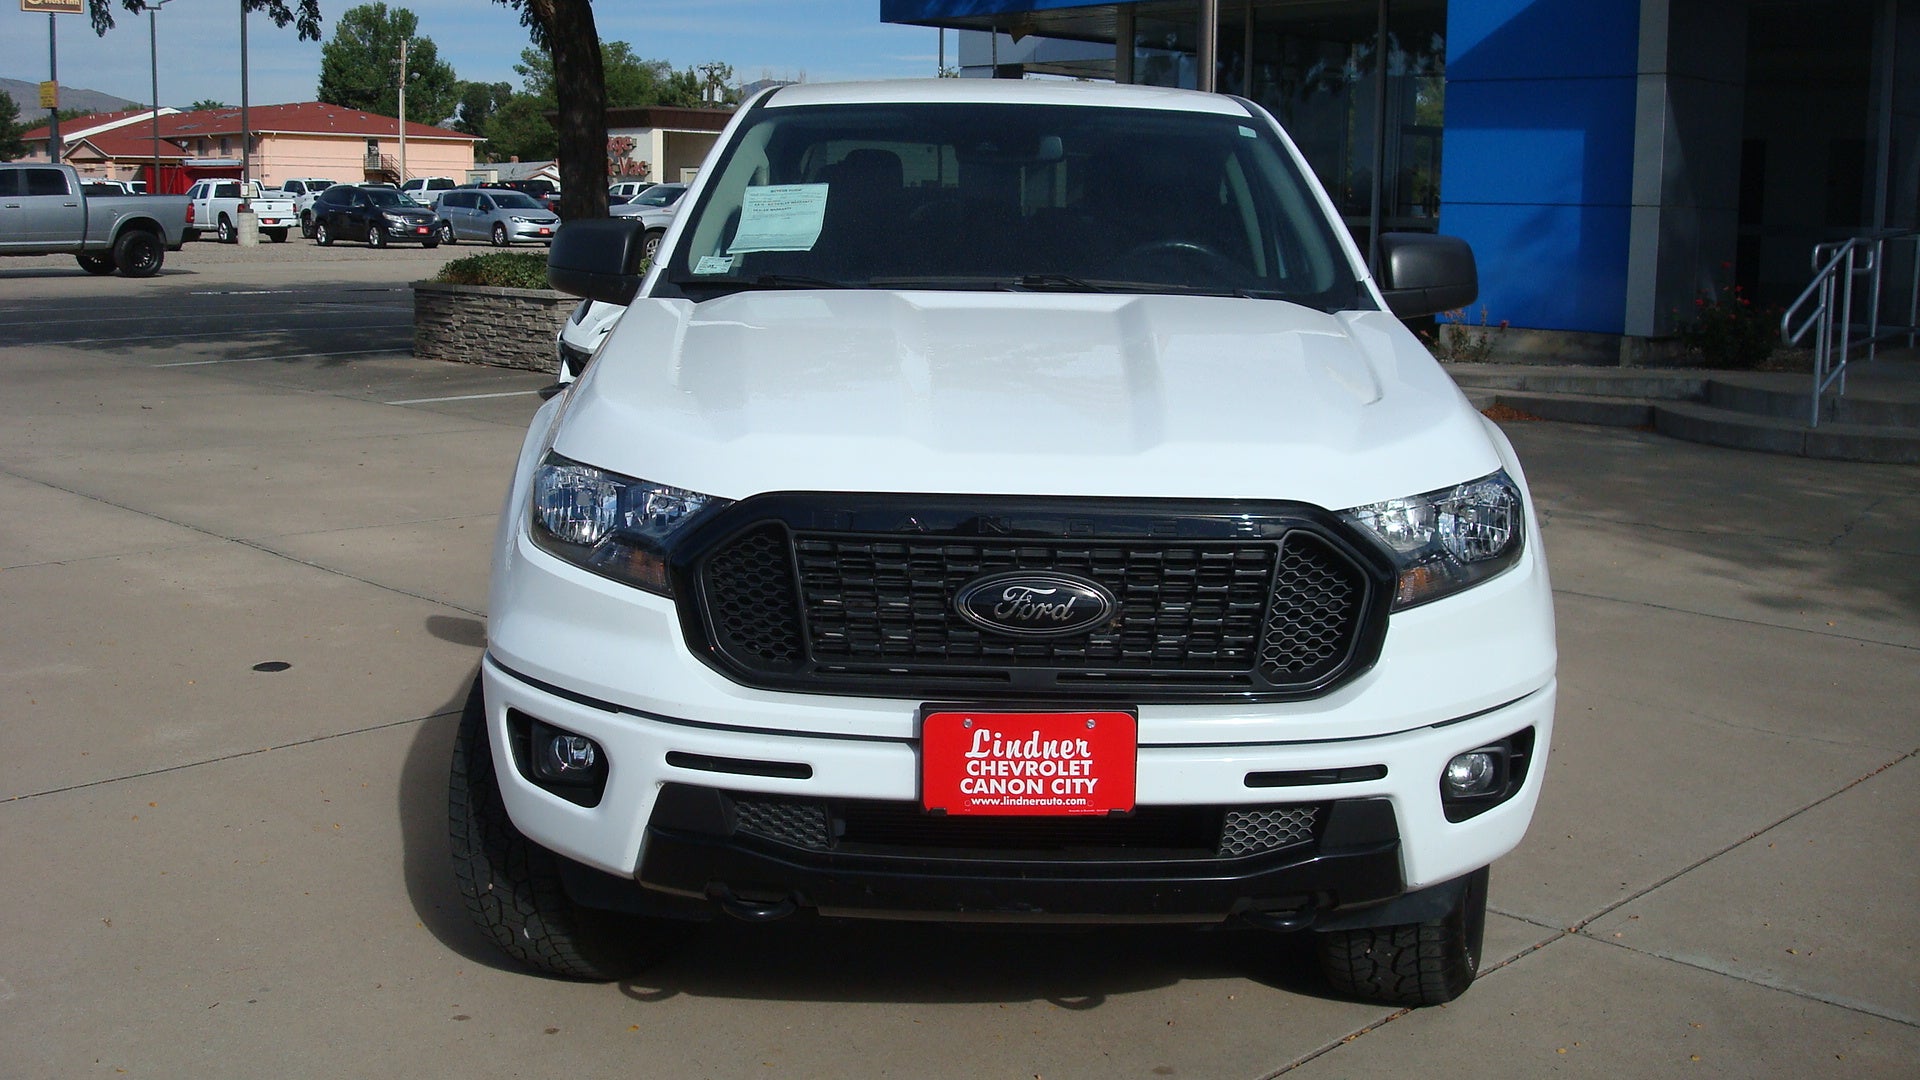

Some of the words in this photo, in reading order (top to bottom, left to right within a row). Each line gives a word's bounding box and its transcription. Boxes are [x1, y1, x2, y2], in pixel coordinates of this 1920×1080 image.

[607, 136, 634, 155] age
[994, 586, 1076, 621] Ford
[964, 728, 1092, 759] Lindner
[966, 760, 1093, 776] CHEVROLET
[960, 778, 1044, 795] CANON
[1051, 778, 1098, 794] CITY
[971, 796, 1087, 807] www.lindnerauto.com
